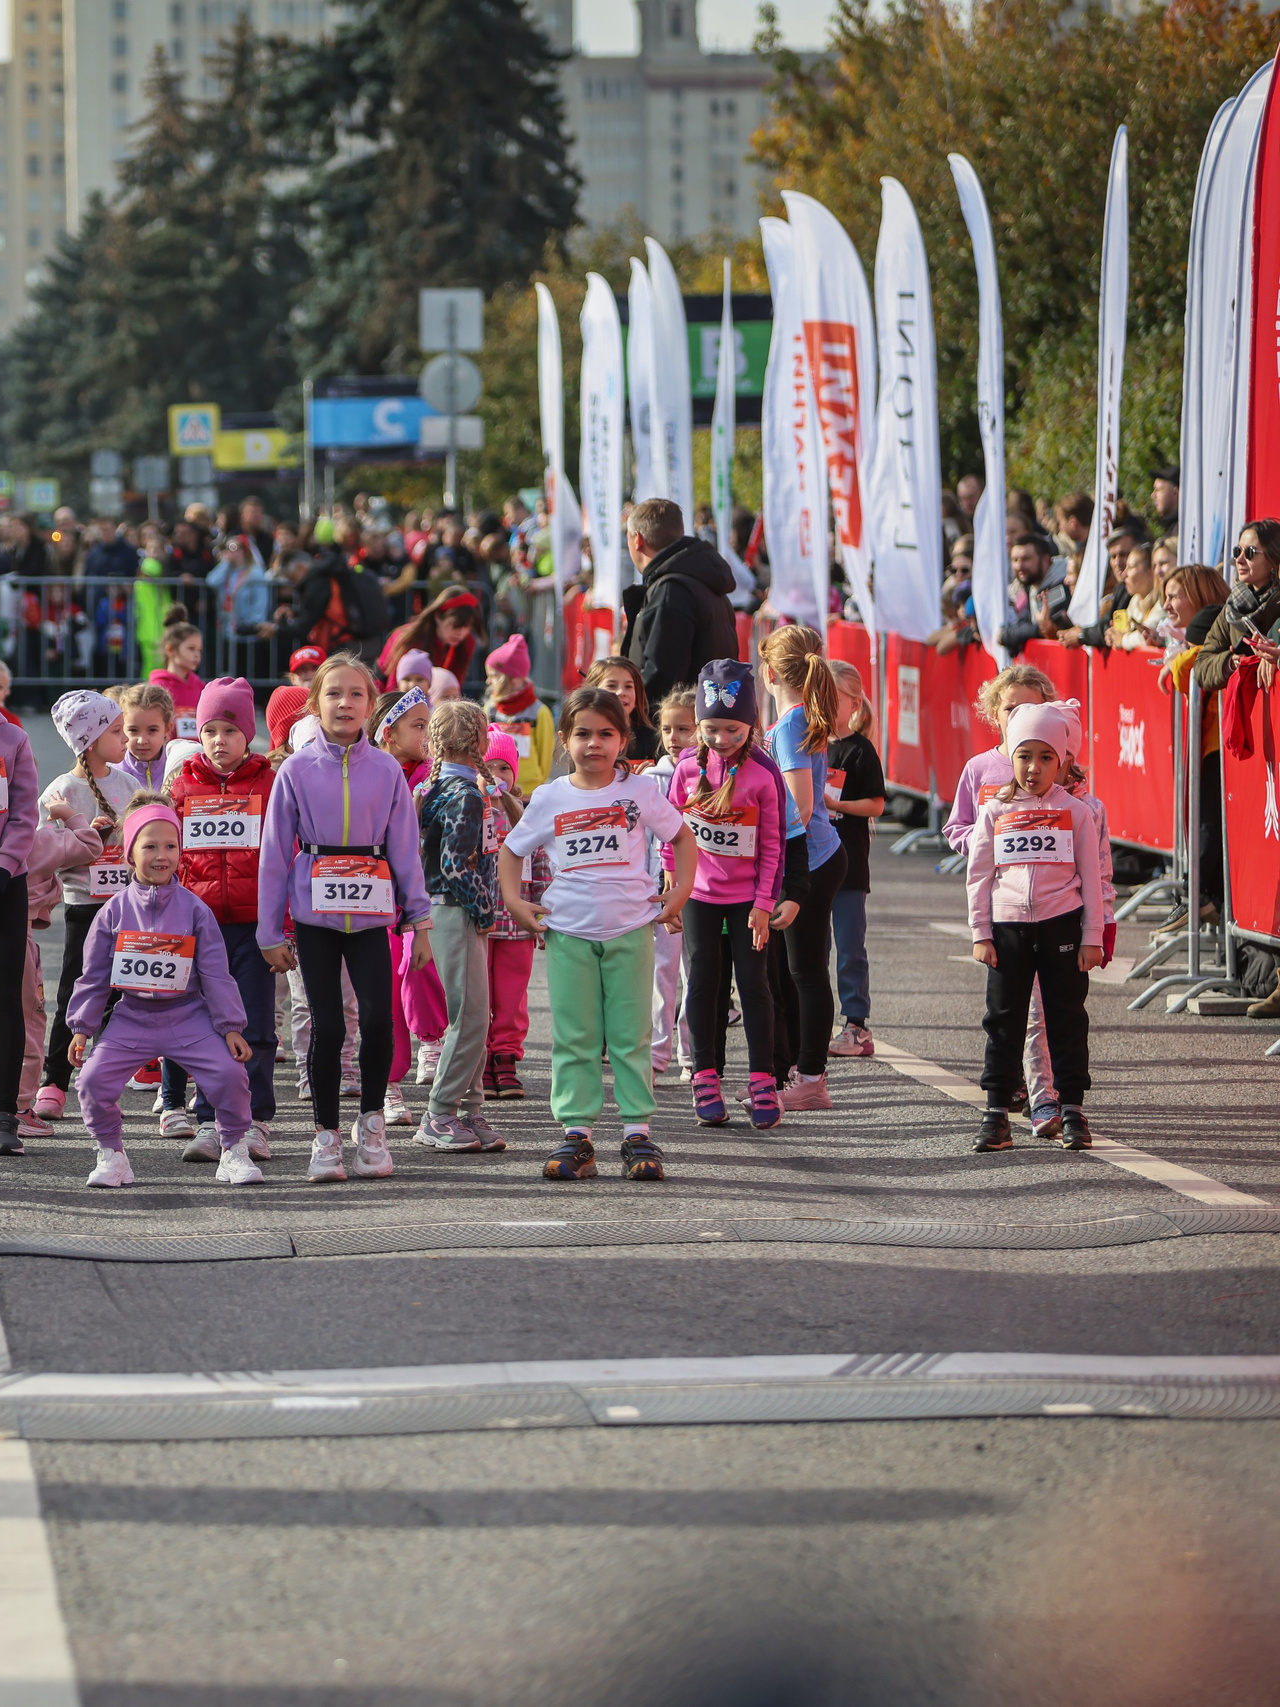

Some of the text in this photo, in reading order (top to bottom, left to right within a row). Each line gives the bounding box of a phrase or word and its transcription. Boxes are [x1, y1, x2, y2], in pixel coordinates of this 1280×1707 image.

[190, 821, 245, 837] 3020
[690, 821, 739, 846] 3082
[566, 835, 619, 856] 3274
[1003, 836, 1056, 853] 3292
[97, 870, 129, 886] 335
[324, 884, 373, 900] 3127
[120, 959, 176, 979] 3062
